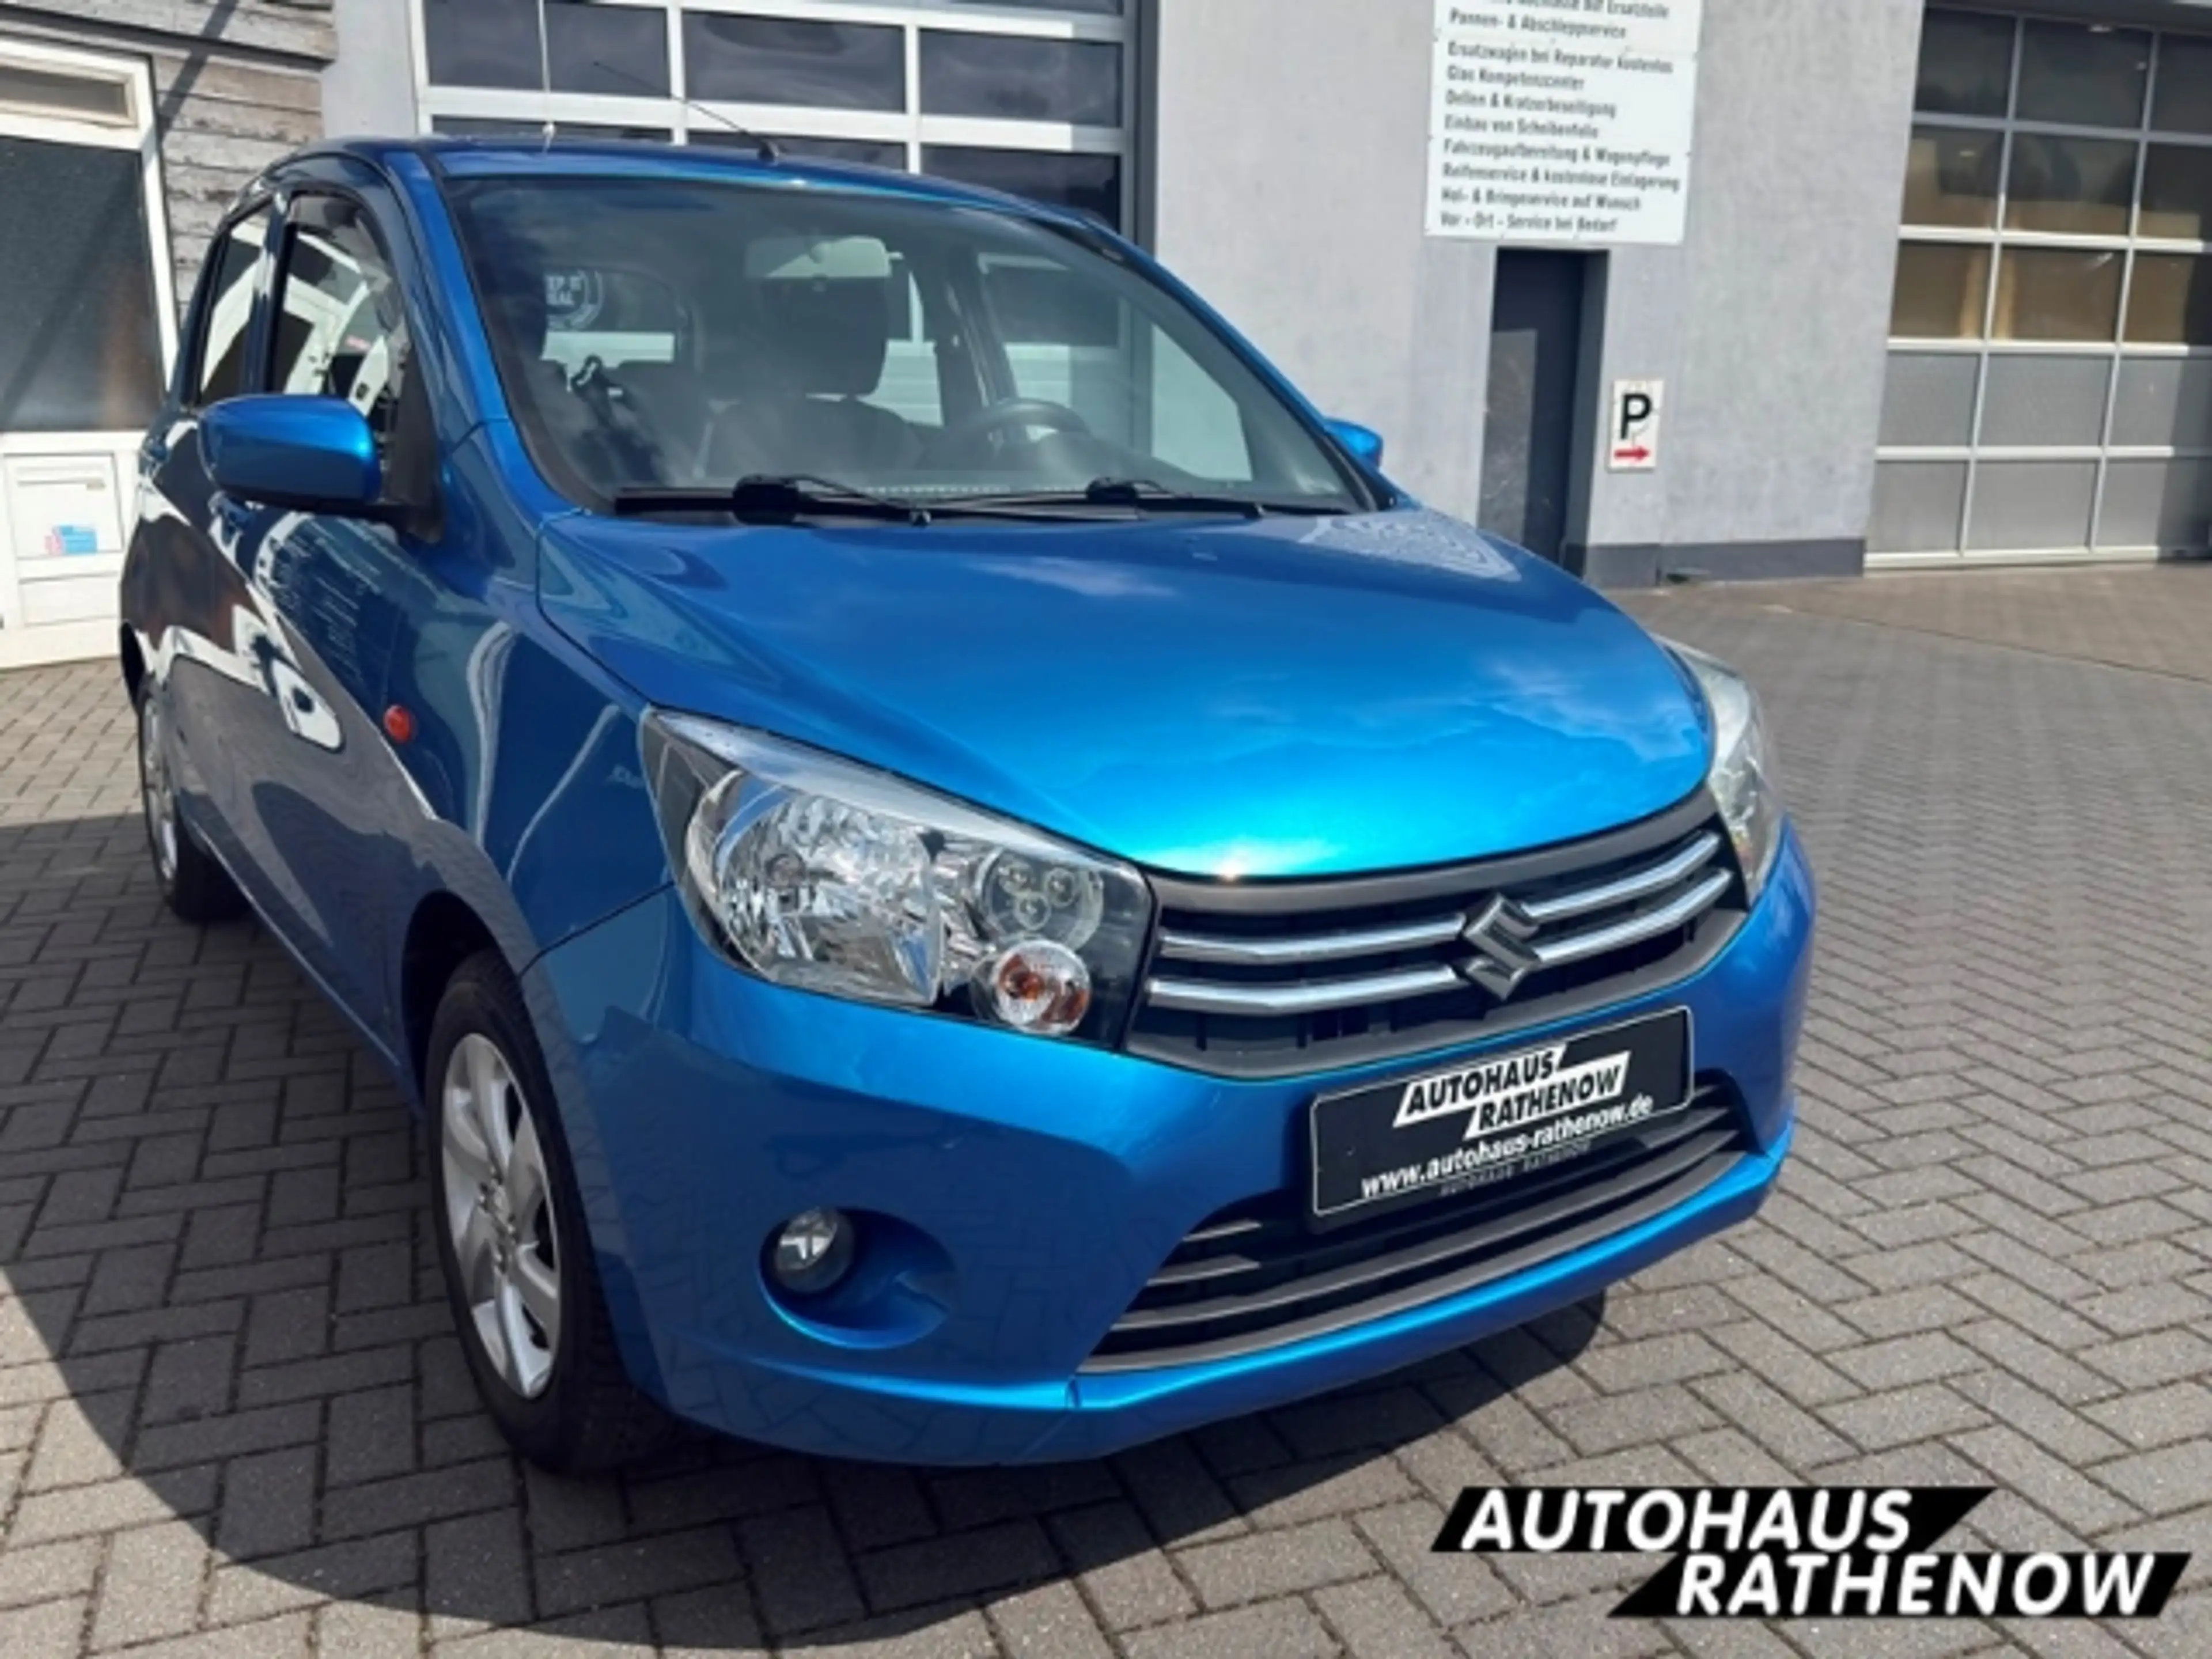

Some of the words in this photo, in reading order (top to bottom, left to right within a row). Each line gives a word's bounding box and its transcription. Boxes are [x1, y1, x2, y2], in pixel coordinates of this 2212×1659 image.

[1449, 7, 1503, 26] Pannen-
[1507, 13, 1516, 29] &
[1521, 14, 1627, 39] Abschleppservice
[1448, 41, 1528, 63] Ersatzwagen
[1531, 47, 1549, 63] bei
[1554, 48, 1613, 70] Reparatur
[1447, 65, 1475, 82] Glas
[1445, 88, 1486, 107] Dellen
[1490, 92, 1499, 108] &
[1503, 94, 1617, 120] Kratzerbeseitigung
[1444, 113, 1487, 132] Einbau
[1493, 120, 1515, 132] von
[1517, 117, 1599, 139] Scheibenfolie
[1444, 137, 1577, 164] Fahrzeugaufbereitung
[1582, 147, 1591, 162] &
[1595, 147, 1671, 171] Wagenpflege
[1443, 161, 1527, 183] Reifenservice
[1531, 166, 1540, 184] &
[1611, 171, 1680, 195] Einlagerung
[1472, 186, 1481, 204] &
[1572, 194, 1592, 209] auf
[1596, 194, 1641, 211] Wunsch
[1441, 211, 1462, 227] Vor
[1474, 211, 1495, 229] Ort
[1506, 213, 1552, 230] Service
[1555, 217, 1573, 230] bei
[1577, 217, 1618, 233] Bedarf
[1620, 393, 1652, 440] P
[1406, 1050, 1554, 1115] AUTOHAUS
[1478, 1065, 1621, 1130] RATHENOW
[1361, 1094, 1654, 1199] www.autohaus-rathenow.de
